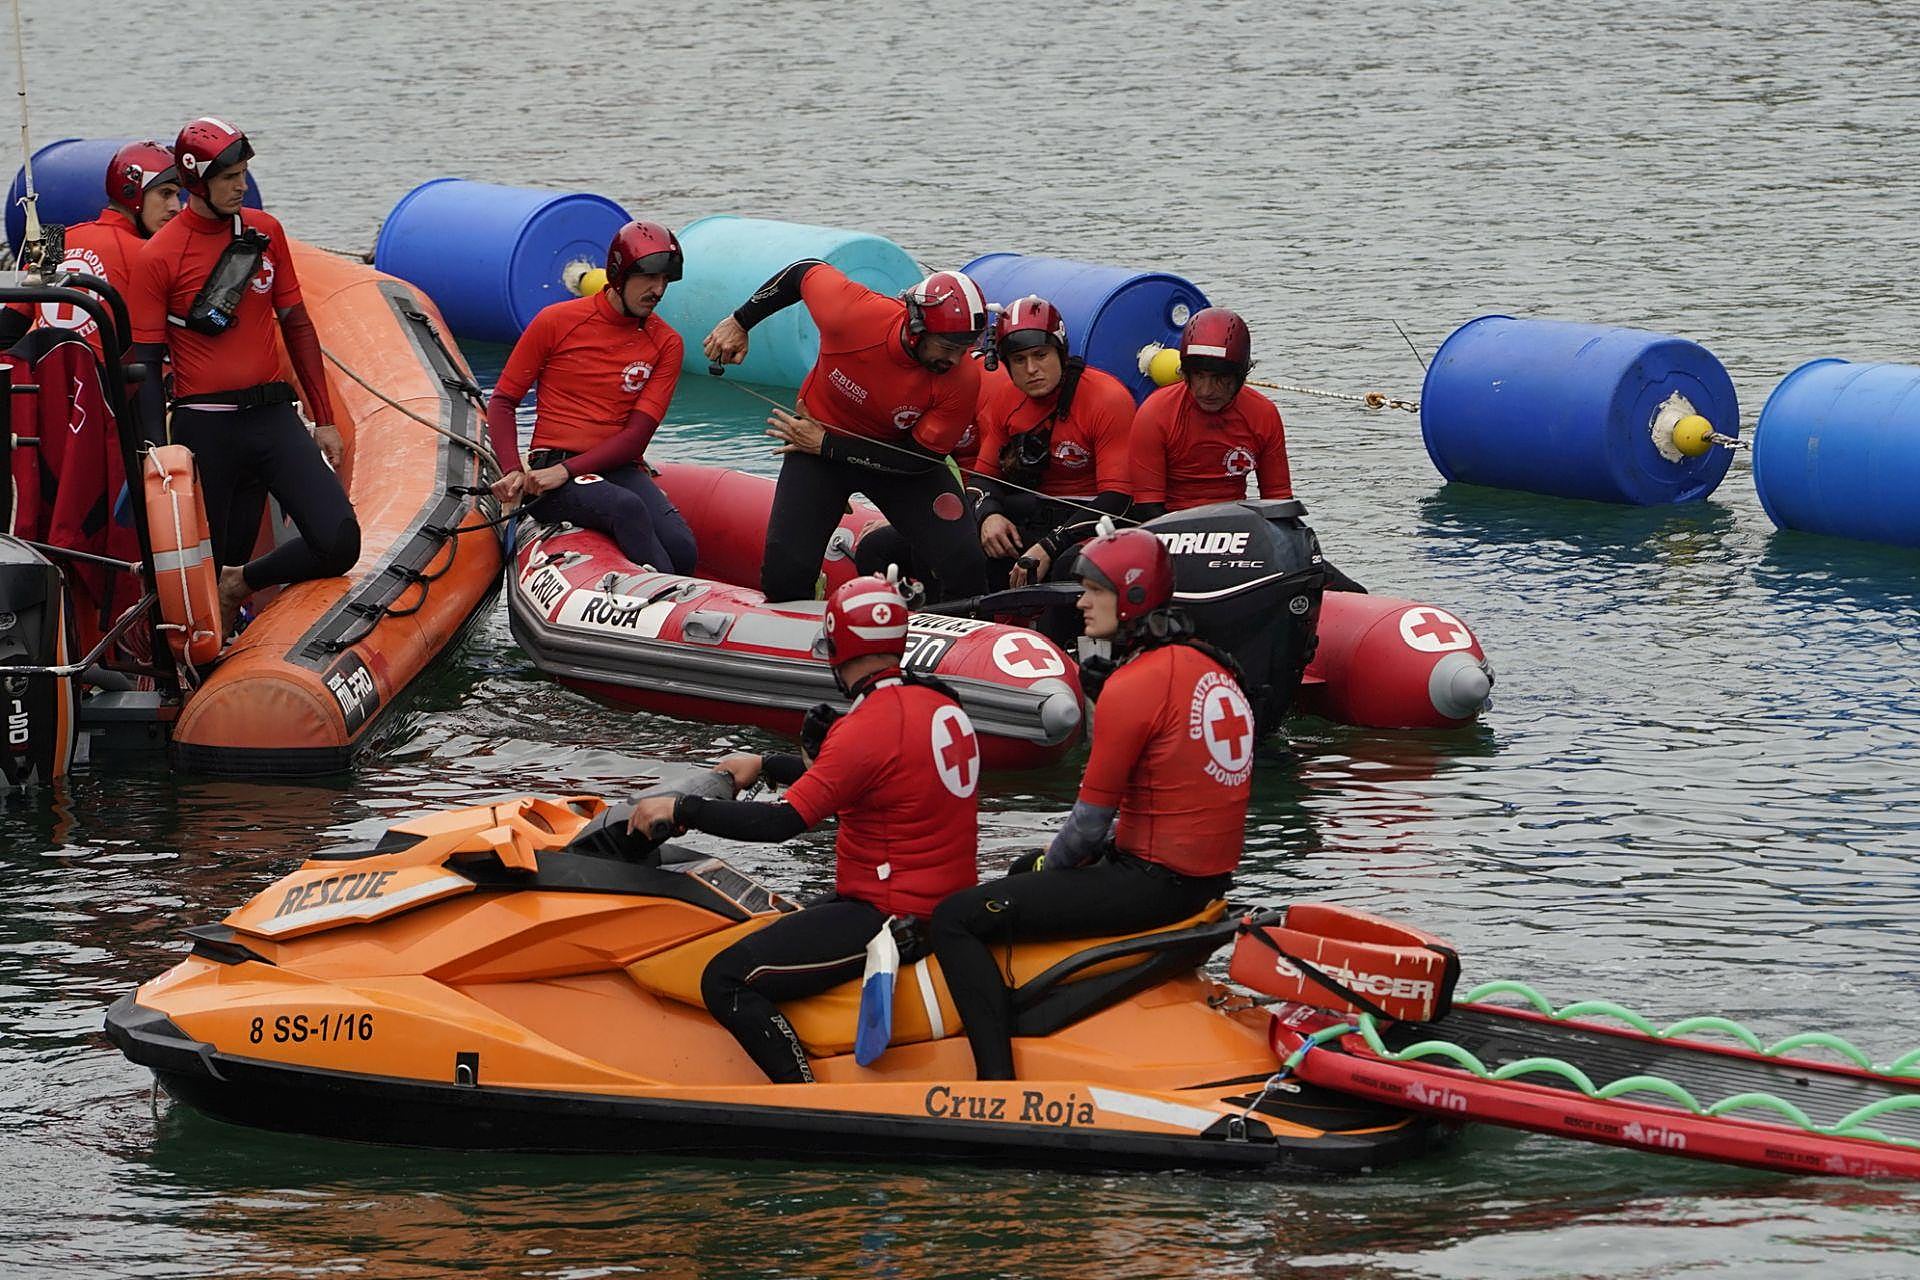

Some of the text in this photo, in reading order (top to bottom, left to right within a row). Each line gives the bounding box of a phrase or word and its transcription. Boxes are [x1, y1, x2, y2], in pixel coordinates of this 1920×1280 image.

[830, 368, 868, 399] EBUSS
[1155, 533, 1250, 554] NRUDE
[1208, 560, 1264, 569] E-TEC
[530, 569, 642, 629] CRUZ ROJA
[8, 700, 29, 744] 150
[274, 871, 397, 918] RESCUE
[250, 1013, 373, 1044] 8 SS-1/16
[925, 1086, 1095, 1127] Cruz Roja
[1405, 1081, 1467, 1112] Arin
[1622, 1120, 1687, 1150] Arin
